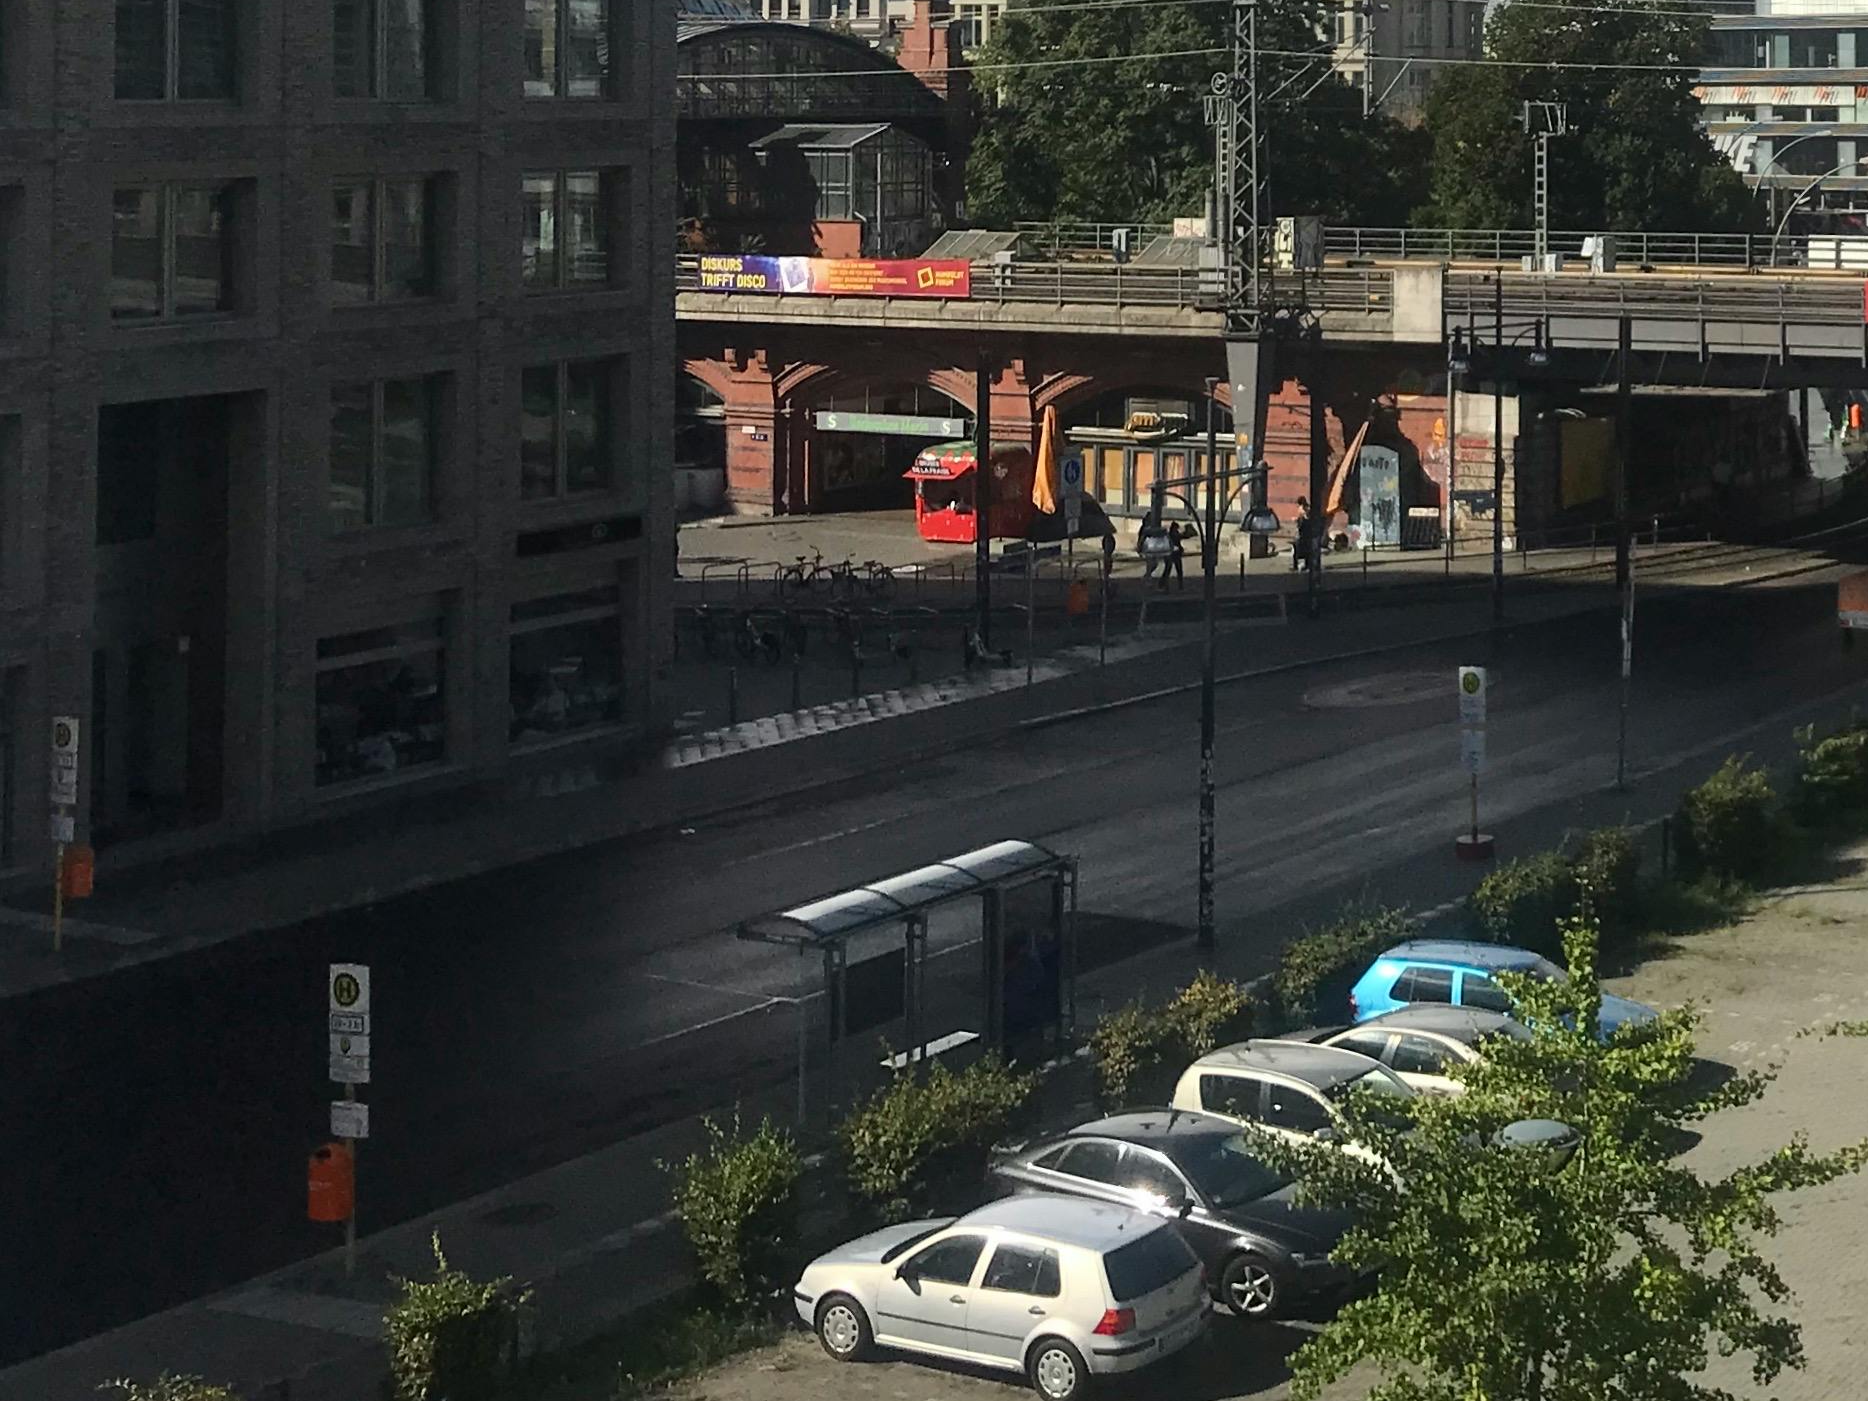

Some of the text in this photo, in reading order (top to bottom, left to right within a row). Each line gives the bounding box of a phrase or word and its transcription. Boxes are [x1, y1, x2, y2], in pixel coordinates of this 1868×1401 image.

[701, 257, 742, 271] DISKURS
[701, 273, 766, 288] TRIFFT DISCO
